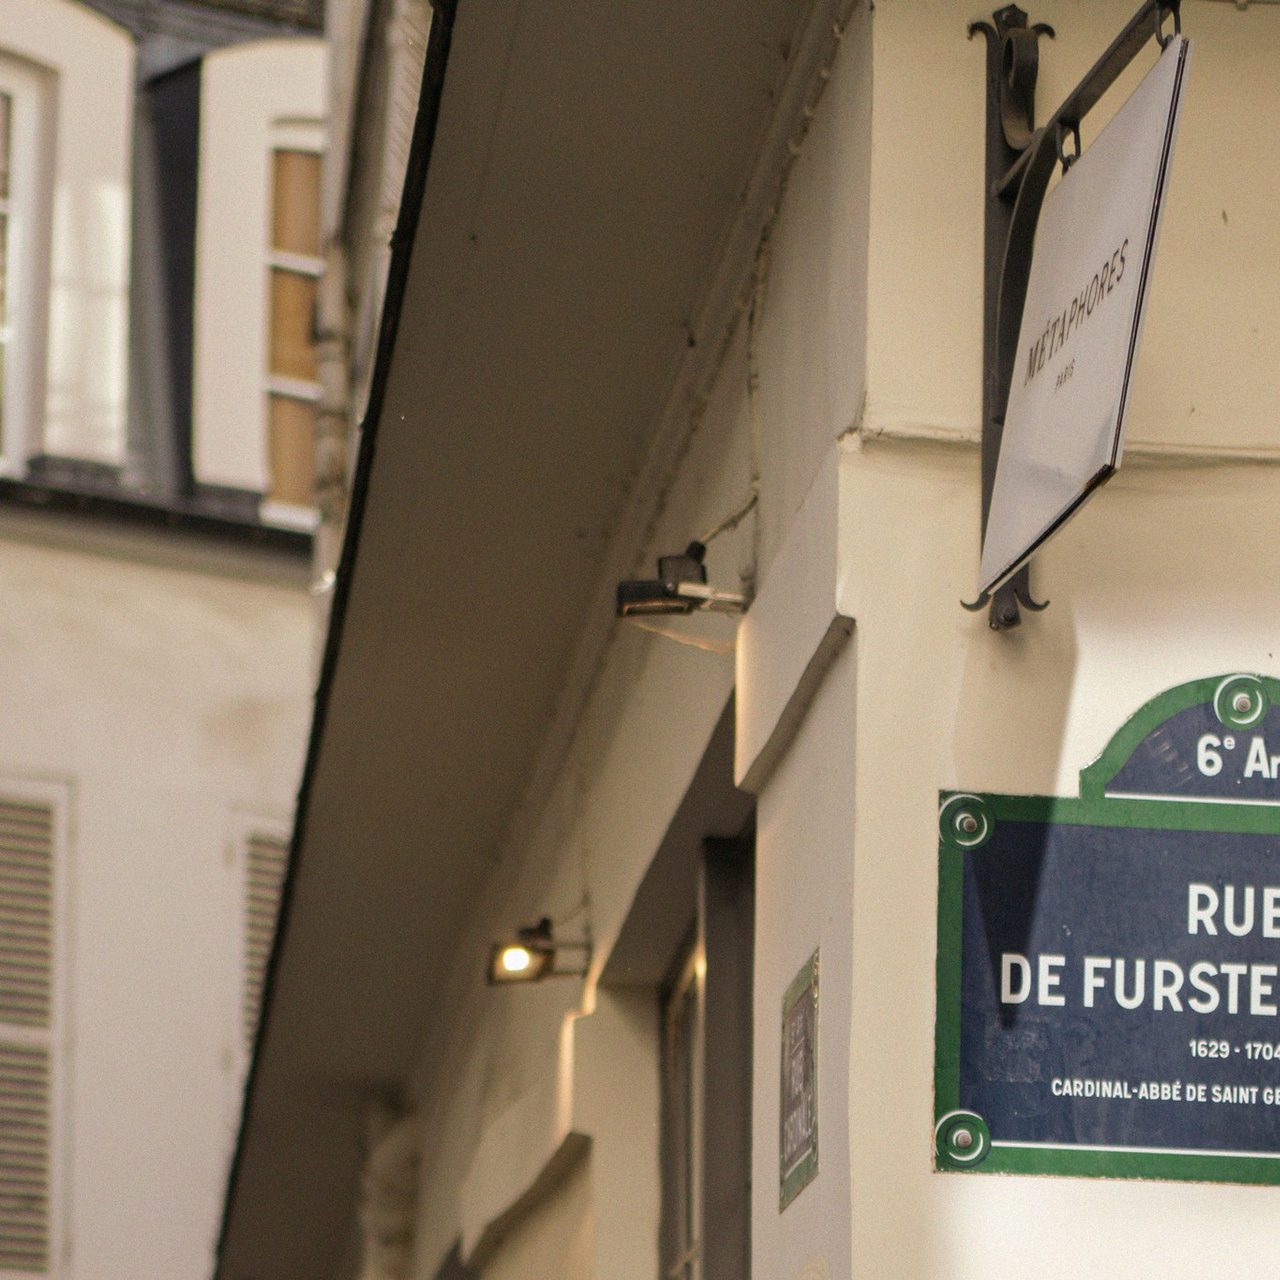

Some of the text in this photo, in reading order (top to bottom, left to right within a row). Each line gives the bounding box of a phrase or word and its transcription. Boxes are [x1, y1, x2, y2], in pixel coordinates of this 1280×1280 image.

[1054, 358, 1075, 394] PARIS
[1001, 953, 1066, 1007] DE
[1189, 1040, 1230, 1059] 1629
[1051, 1078, 1182, 1102] CARDINAL-ABBÉ
[1185, 1083, 1207, 1103] DE
[1211, 1085, 1259, 1105] SAINT
